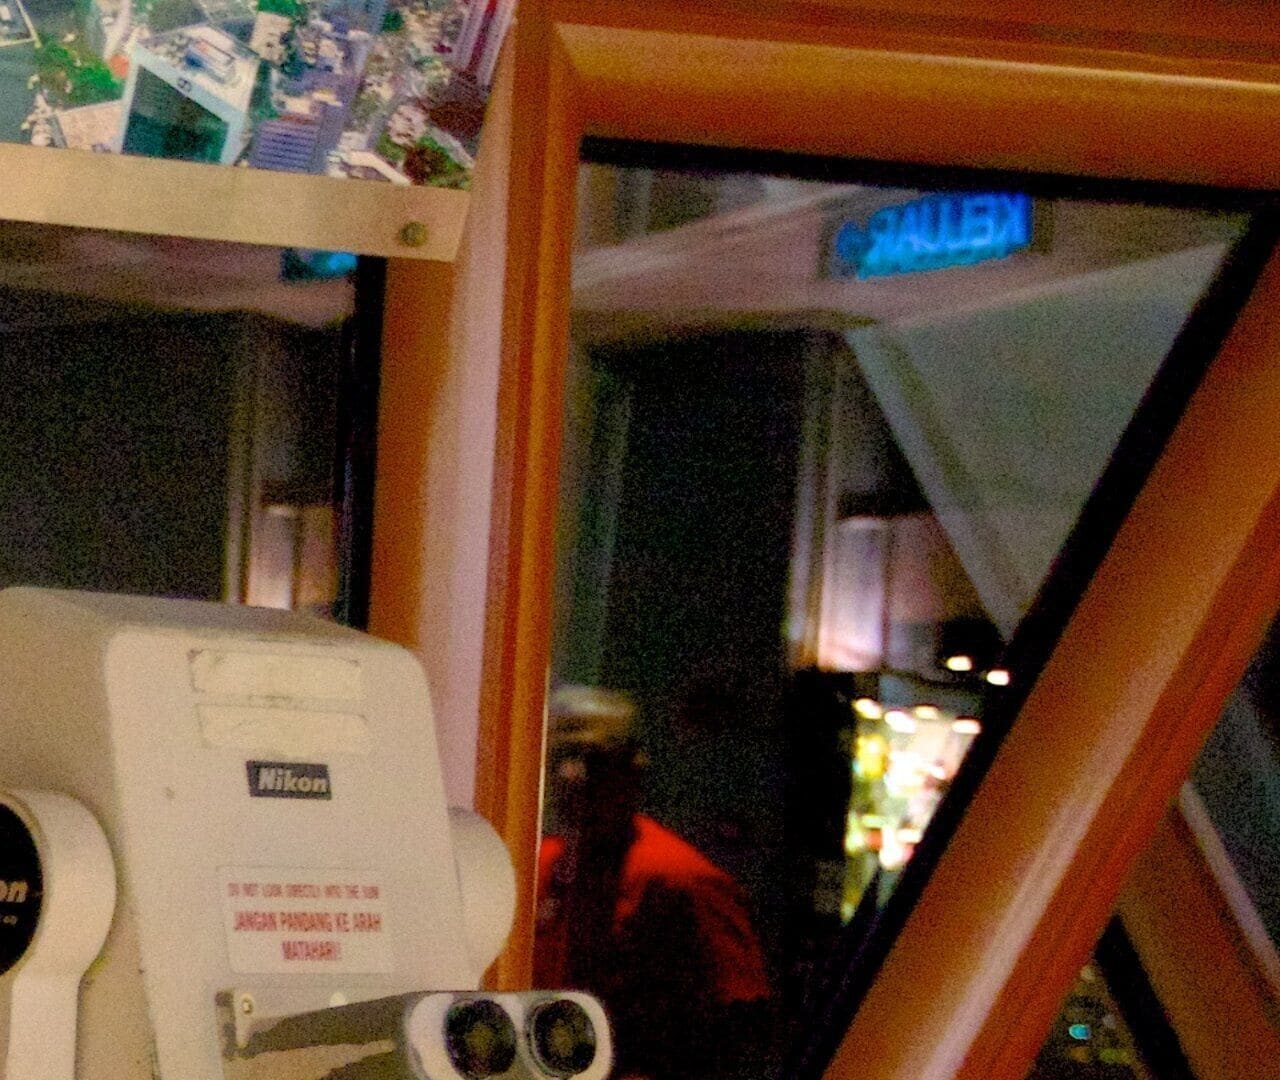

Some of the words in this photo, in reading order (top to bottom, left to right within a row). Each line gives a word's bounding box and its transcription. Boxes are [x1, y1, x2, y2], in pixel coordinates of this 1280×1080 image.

[258, 767, 328, 793] Nikon
[234, 911, 277, 932] JANGAN
[280, 911, 332, 932] PANDANG
[335, 911, 350, 932] KE
[353, 911, 382, 933] ARAH
